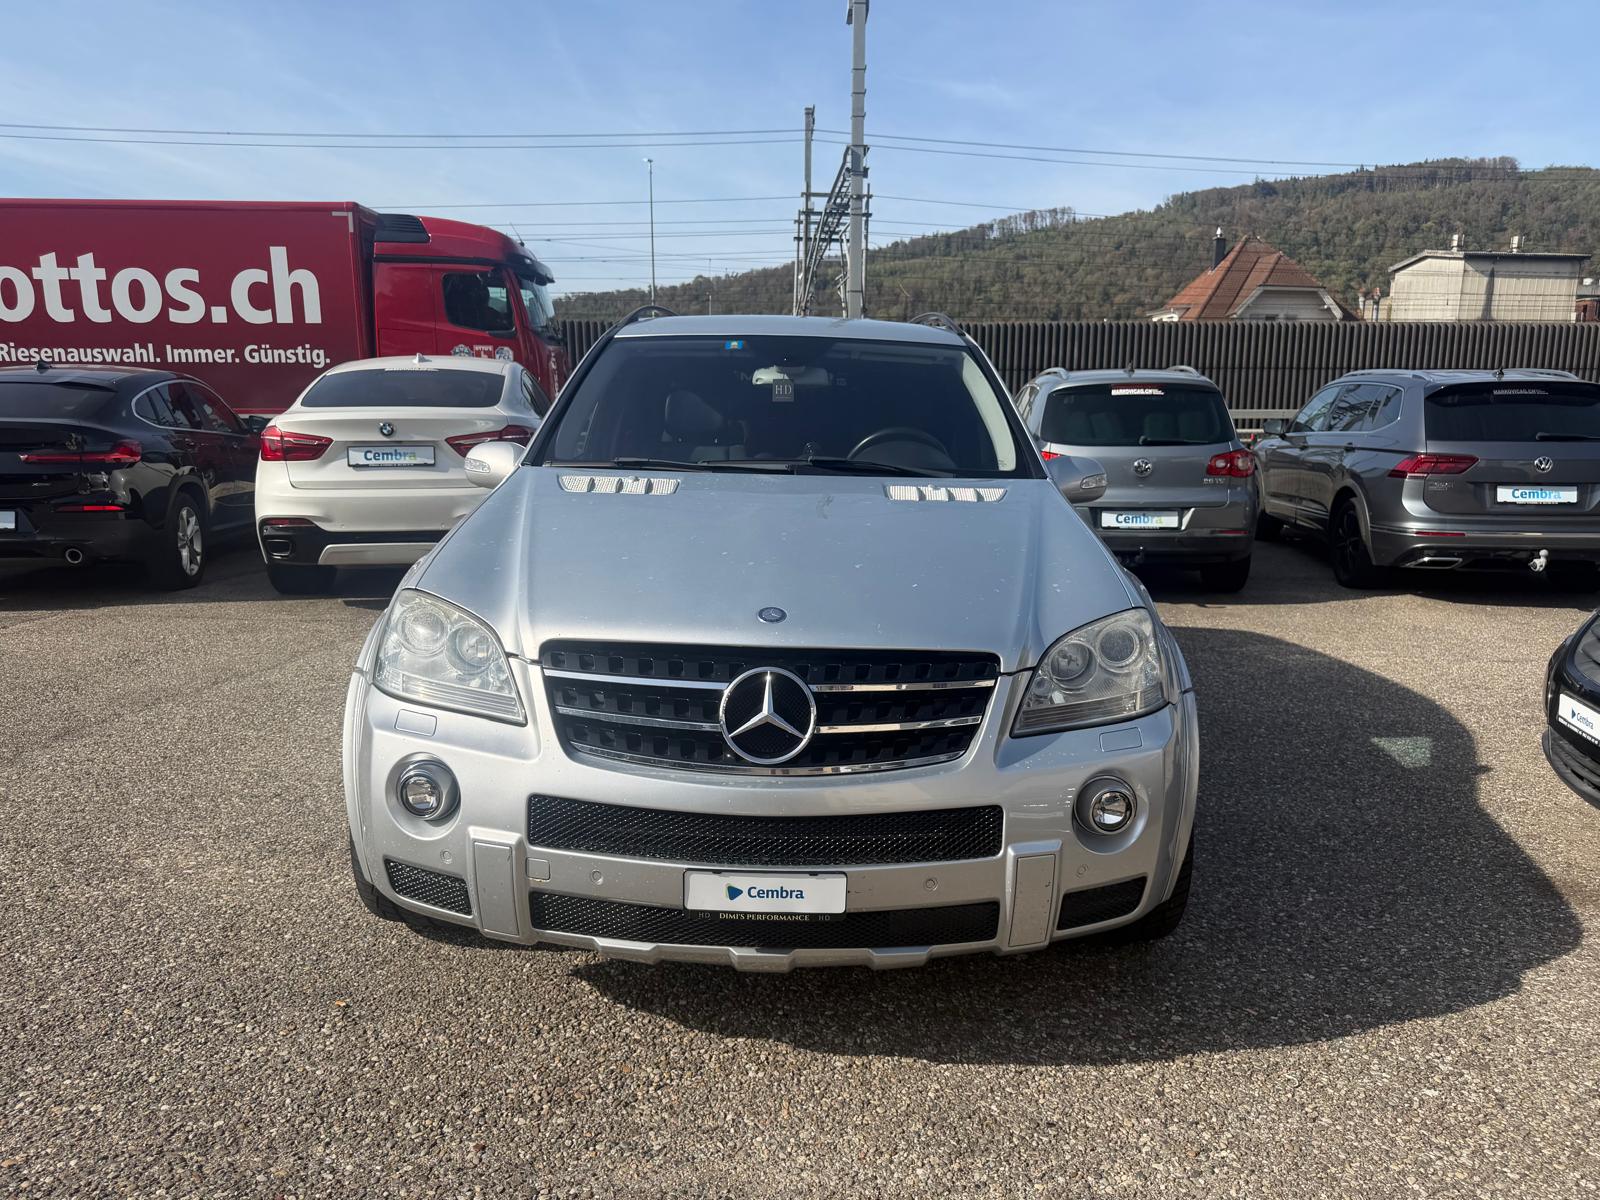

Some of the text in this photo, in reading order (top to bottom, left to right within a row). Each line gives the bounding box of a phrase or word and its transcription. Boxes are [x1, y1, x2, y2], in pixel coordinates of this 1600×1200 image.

[0, 342, 331, 368] Riesenauswahl. Immer. Günstig.
[775, 384, 792, 395] HD
[364, 449, 416, 461] Cembra
[1511, 488, 1562, 500] Cembra
[1115, 513, 1163, 525] Cembra
[747, 886, 805, 899] Cembra
[719, 912, 745, 920] DIMI'S
[746, 913, 810, 922] PERFORMANCE
